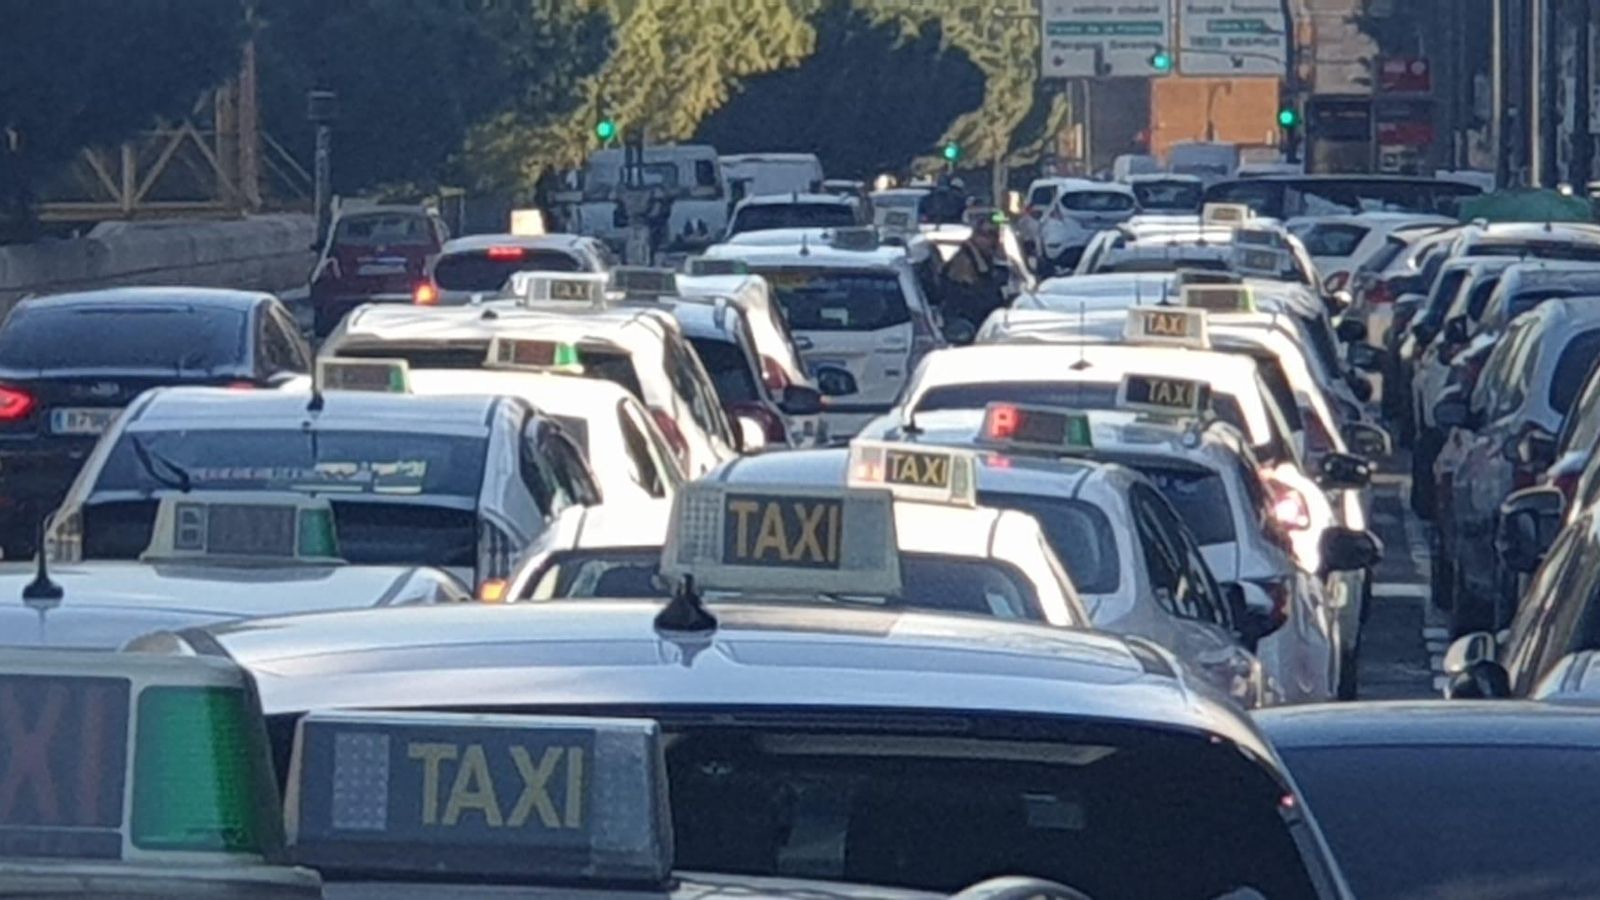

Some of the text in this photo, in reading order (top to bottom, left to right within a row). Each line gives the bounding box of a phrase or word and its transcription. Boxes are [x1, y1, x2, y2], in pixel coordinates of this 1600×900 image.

[1147, 312, 1187, 336] TAXI
[1145, 377, 1195, 407] TAXI
[888, 453, 948, 485] TAXI
[728, 499, 839, 563] TAXI
[408, 740, 584, 829] TAXI
